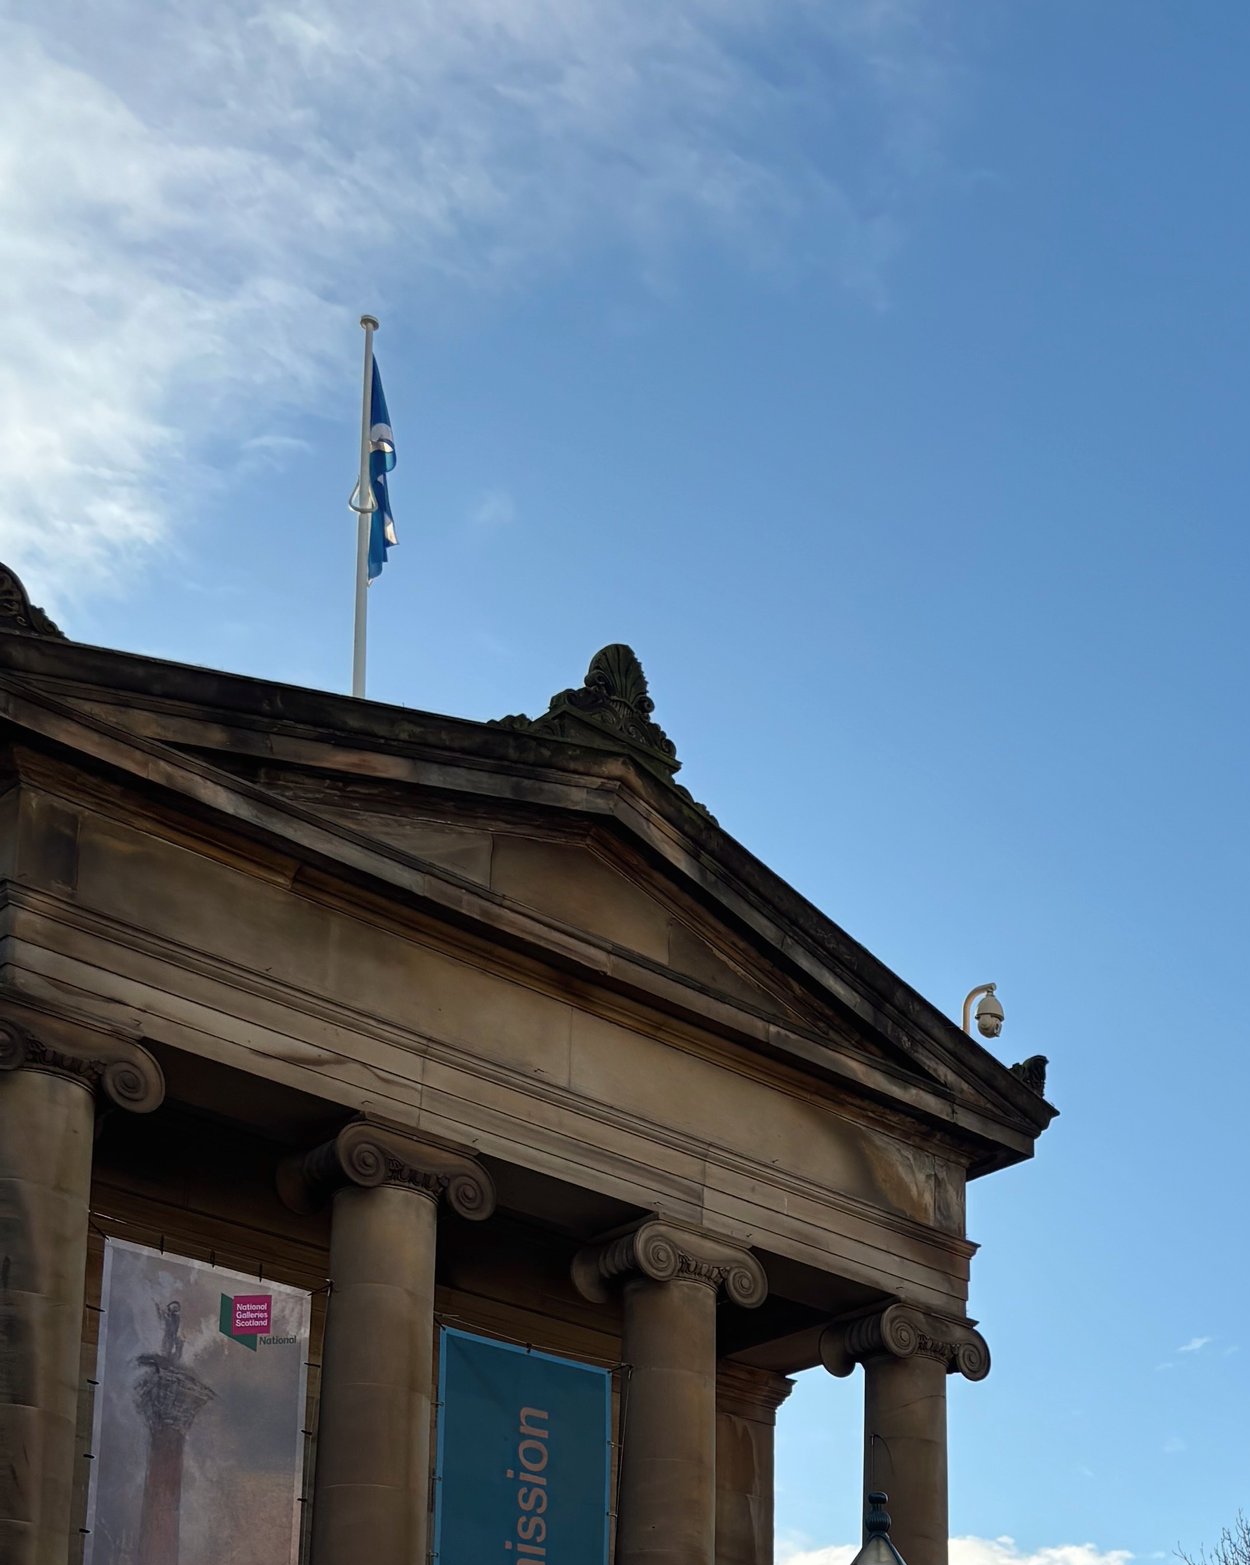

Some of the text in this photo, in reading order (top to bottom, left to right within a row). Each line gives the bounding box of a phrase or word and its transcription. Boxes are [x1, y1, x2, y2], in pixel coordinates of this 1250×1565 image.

[236, 1303, 267, 1311] National
[235, 1311, 268, 1319] Galleries
[235, 1319, 268, 1327] Scotland
[259, 1335, 297, 1345] National
